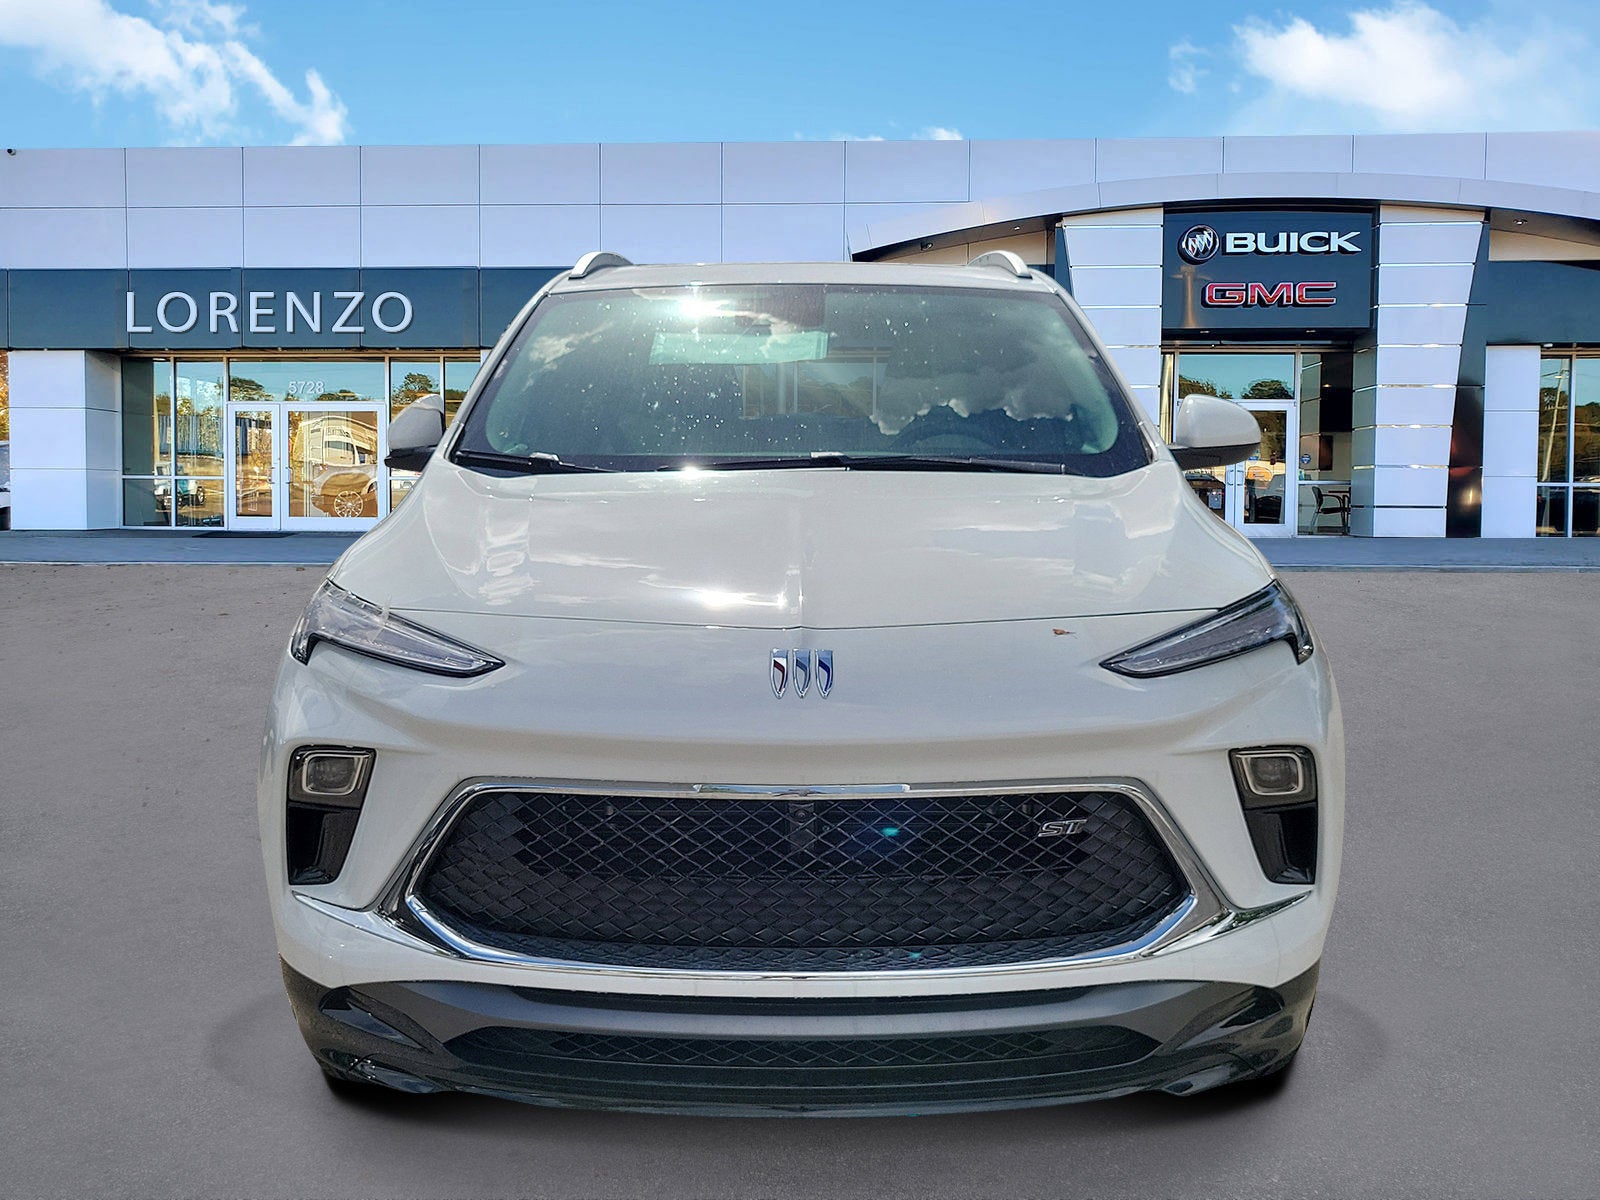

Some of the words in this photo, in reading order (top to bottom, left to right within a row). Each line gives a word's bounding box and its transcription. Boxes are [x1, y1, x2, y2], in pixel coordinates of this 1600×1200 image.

[1225, 231, 1362, 253] BUICK
[1204, 281, 1337, 306] GMC
[125, 290, 414, 334] LORENZO
[288, 380, 325, 394] 5728
[1037, 818, 1088, 838] ST
